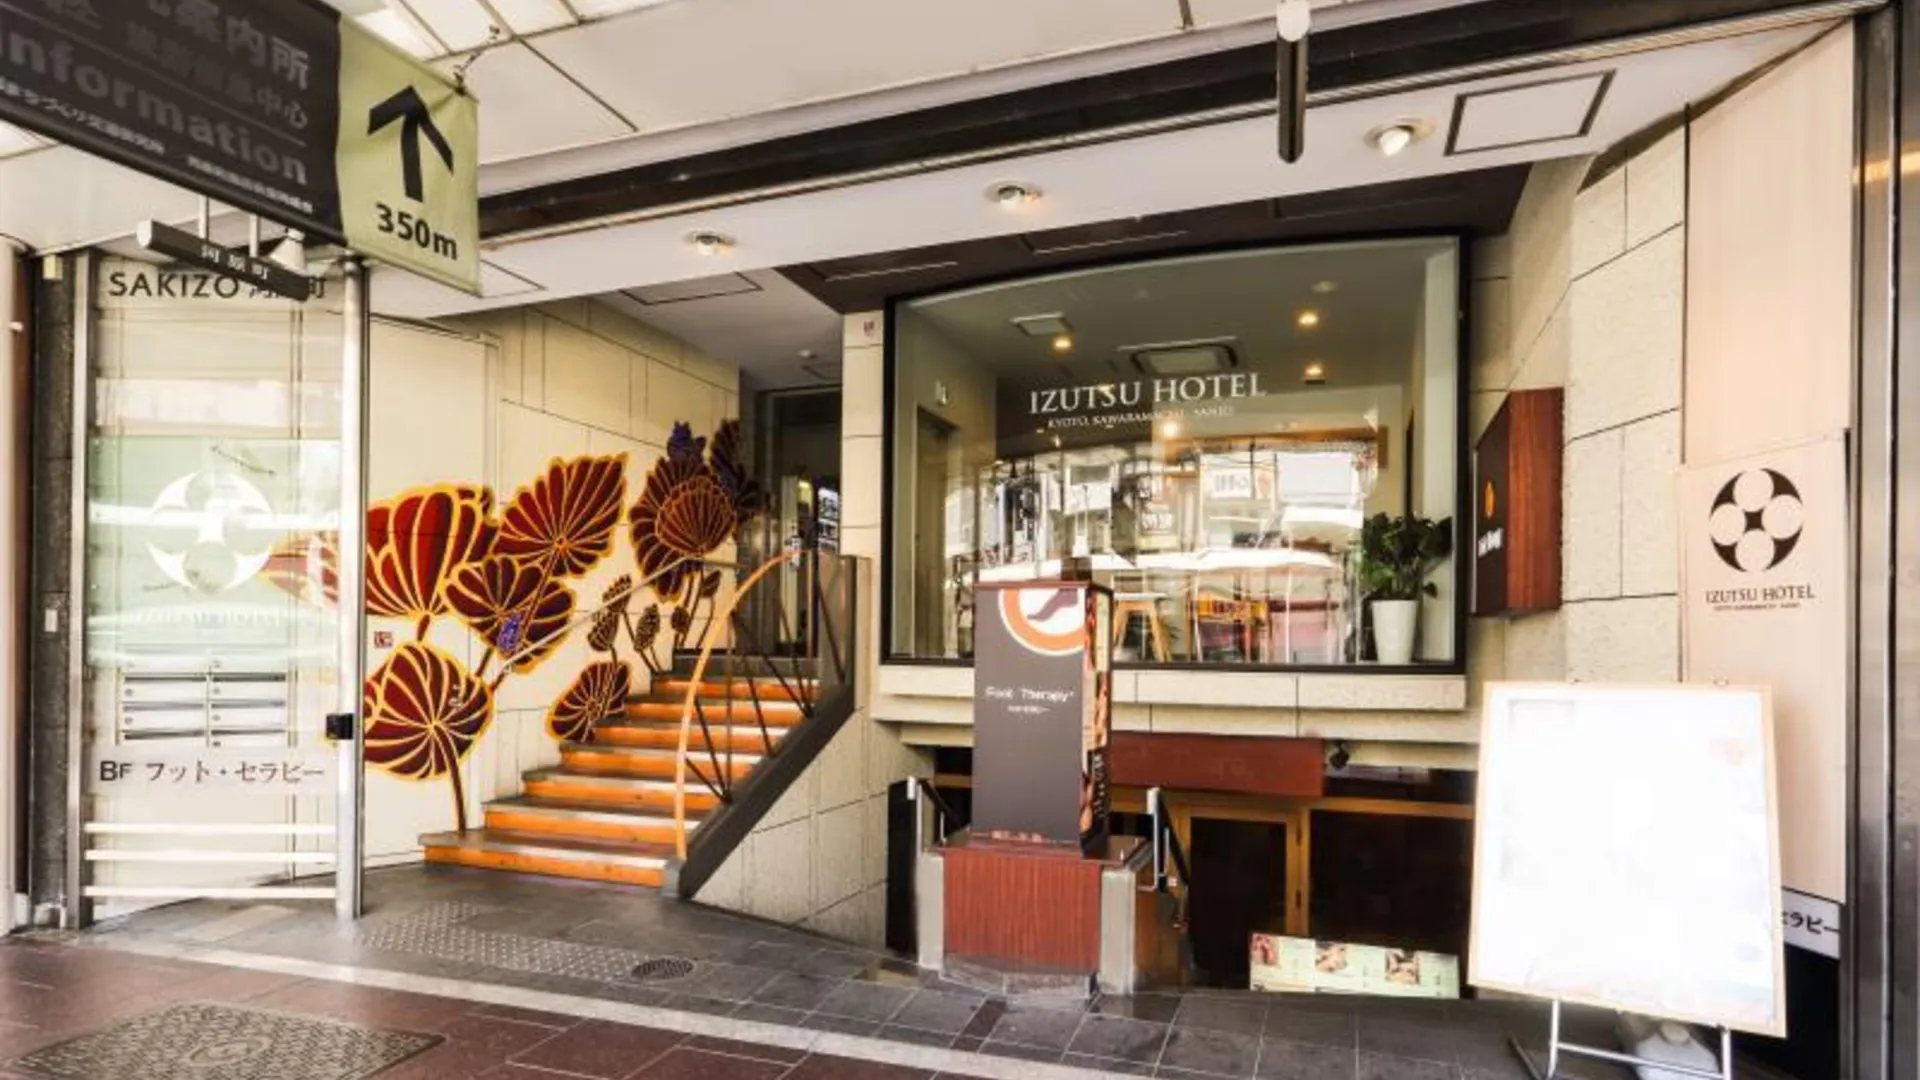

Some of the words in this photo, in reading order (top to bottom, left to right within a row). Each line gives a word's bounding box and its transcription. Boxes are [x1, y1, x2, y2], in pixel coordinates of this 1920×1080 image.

[0, 26, 308, 186] nformation
[375, 200, 458, 262] 350m
[109, 272, 240, 298] SAKIZO
[1029, 381, 1141, 414] IZUTSU
[1153, 372, 1267, 403] HOTEL
[1705, 587, 1758, 604] IZUTSU
[1762, 583, 1816, 600] HOTEL
[99, 760, 133, 782] BF
